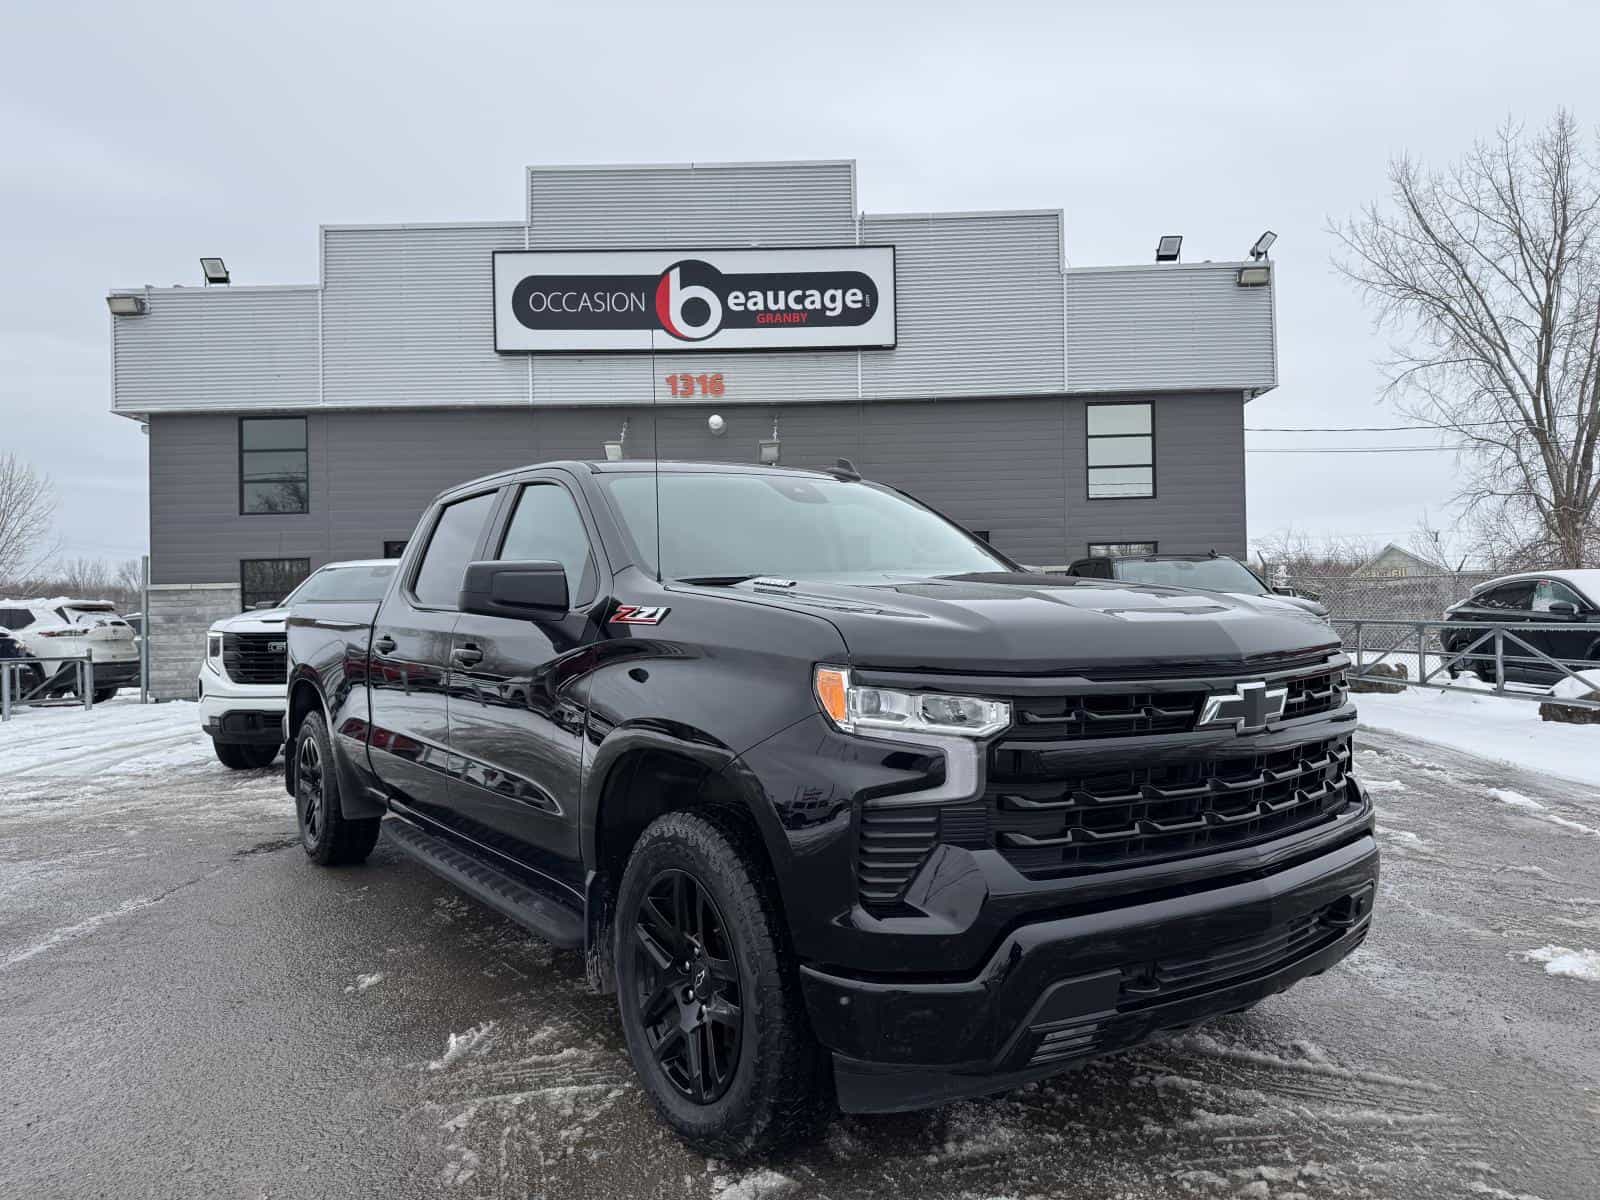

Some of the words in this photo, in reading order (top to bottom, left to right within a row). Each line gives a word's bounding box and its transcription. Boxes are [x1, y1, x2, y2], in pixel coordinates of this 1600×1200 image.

[528, 292, 646, 312] OCCASION
[756, 312, 808, 324] GRANBY
[665, 373, 725, 397] 1316
[609, 605, 671, 625] Z71
